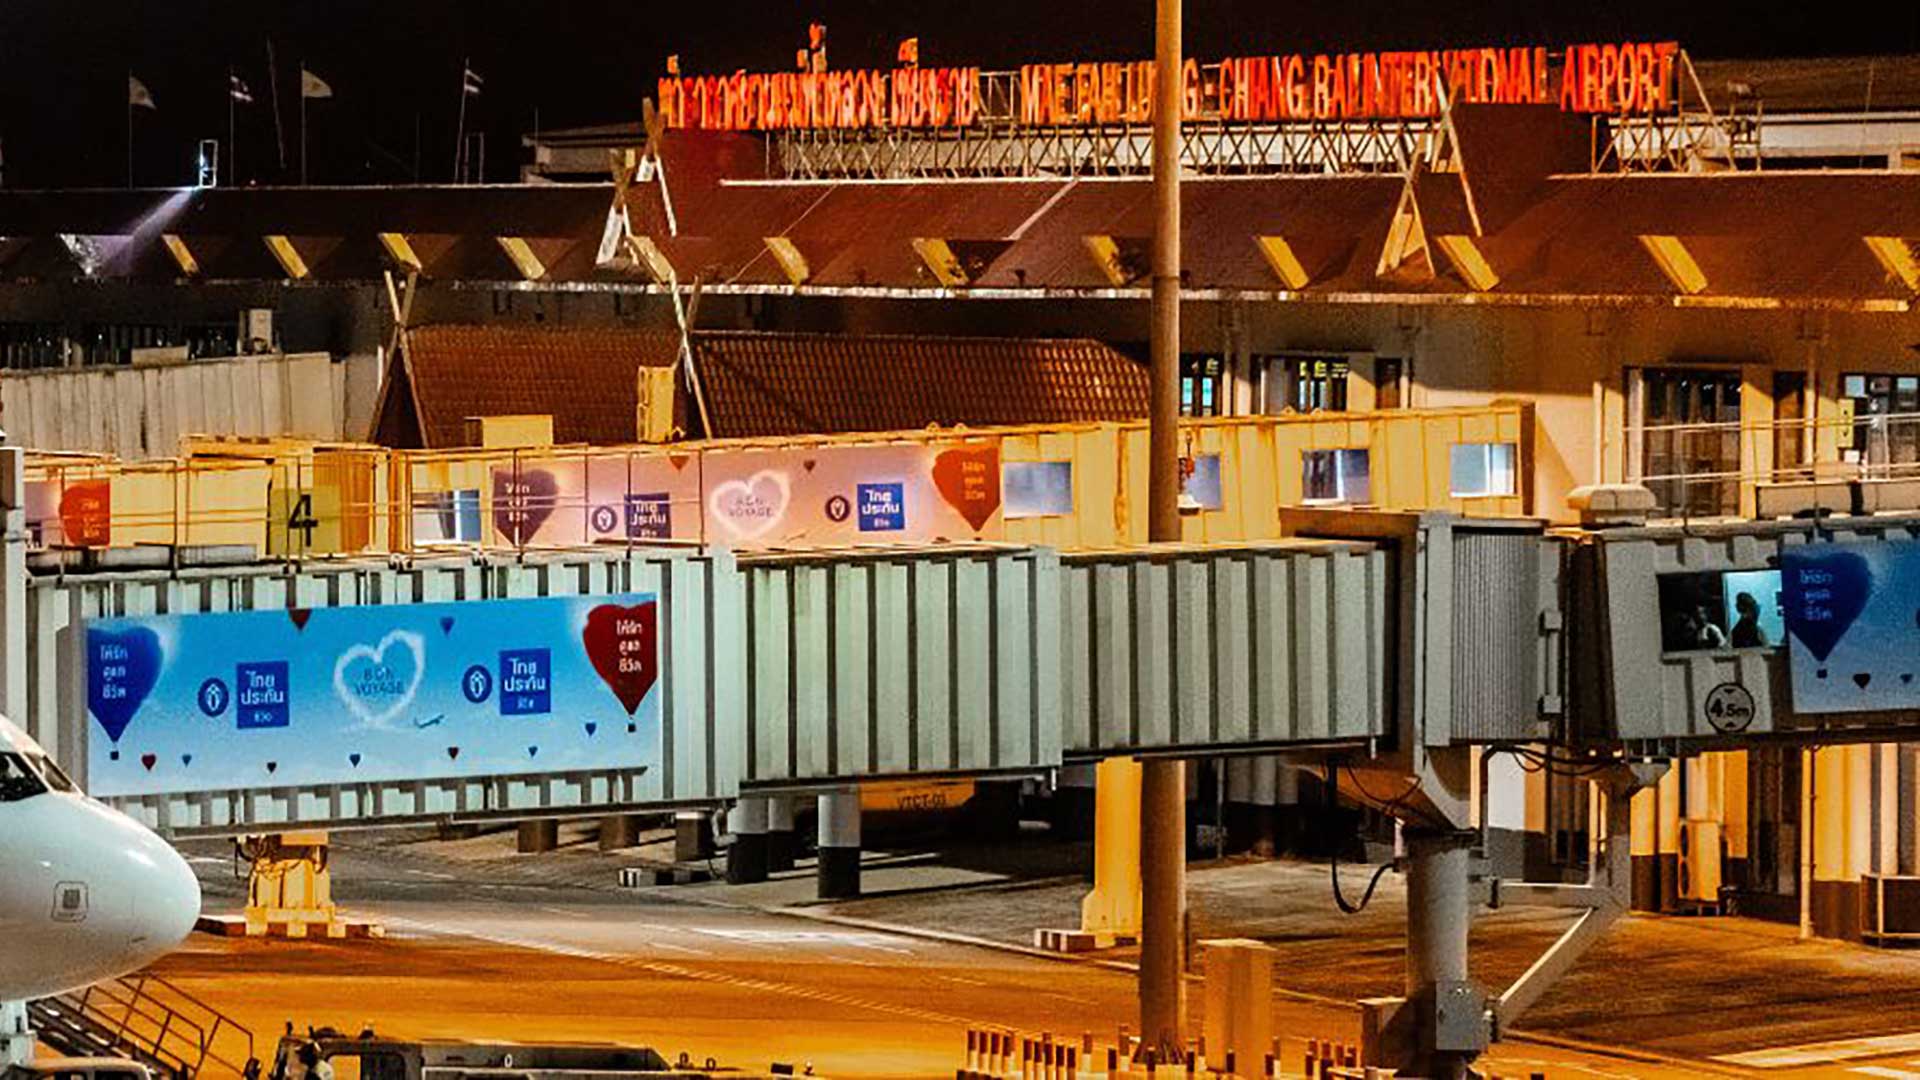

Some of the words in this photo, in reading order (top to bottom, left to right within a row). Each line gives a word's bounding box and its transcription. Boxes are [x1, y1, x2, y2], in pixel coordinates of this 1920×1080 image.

[1021, 64, 1074, 125] MAE
[1077, 63, 1120, 123] FAH
[1126, 57, 1202, 121] LUG
[1219, 54, 1308, 120] CHIANG
[1559, 43, 1677, 113] AIRPORT
[288, 494, 319, 547] 4
[508, 658, 537, 675] ไทย
[245, 670, 275, 688] ไทย
[504, 676, 547, 692] ประกัน
[240, 688, 284, 705] ประกัน
